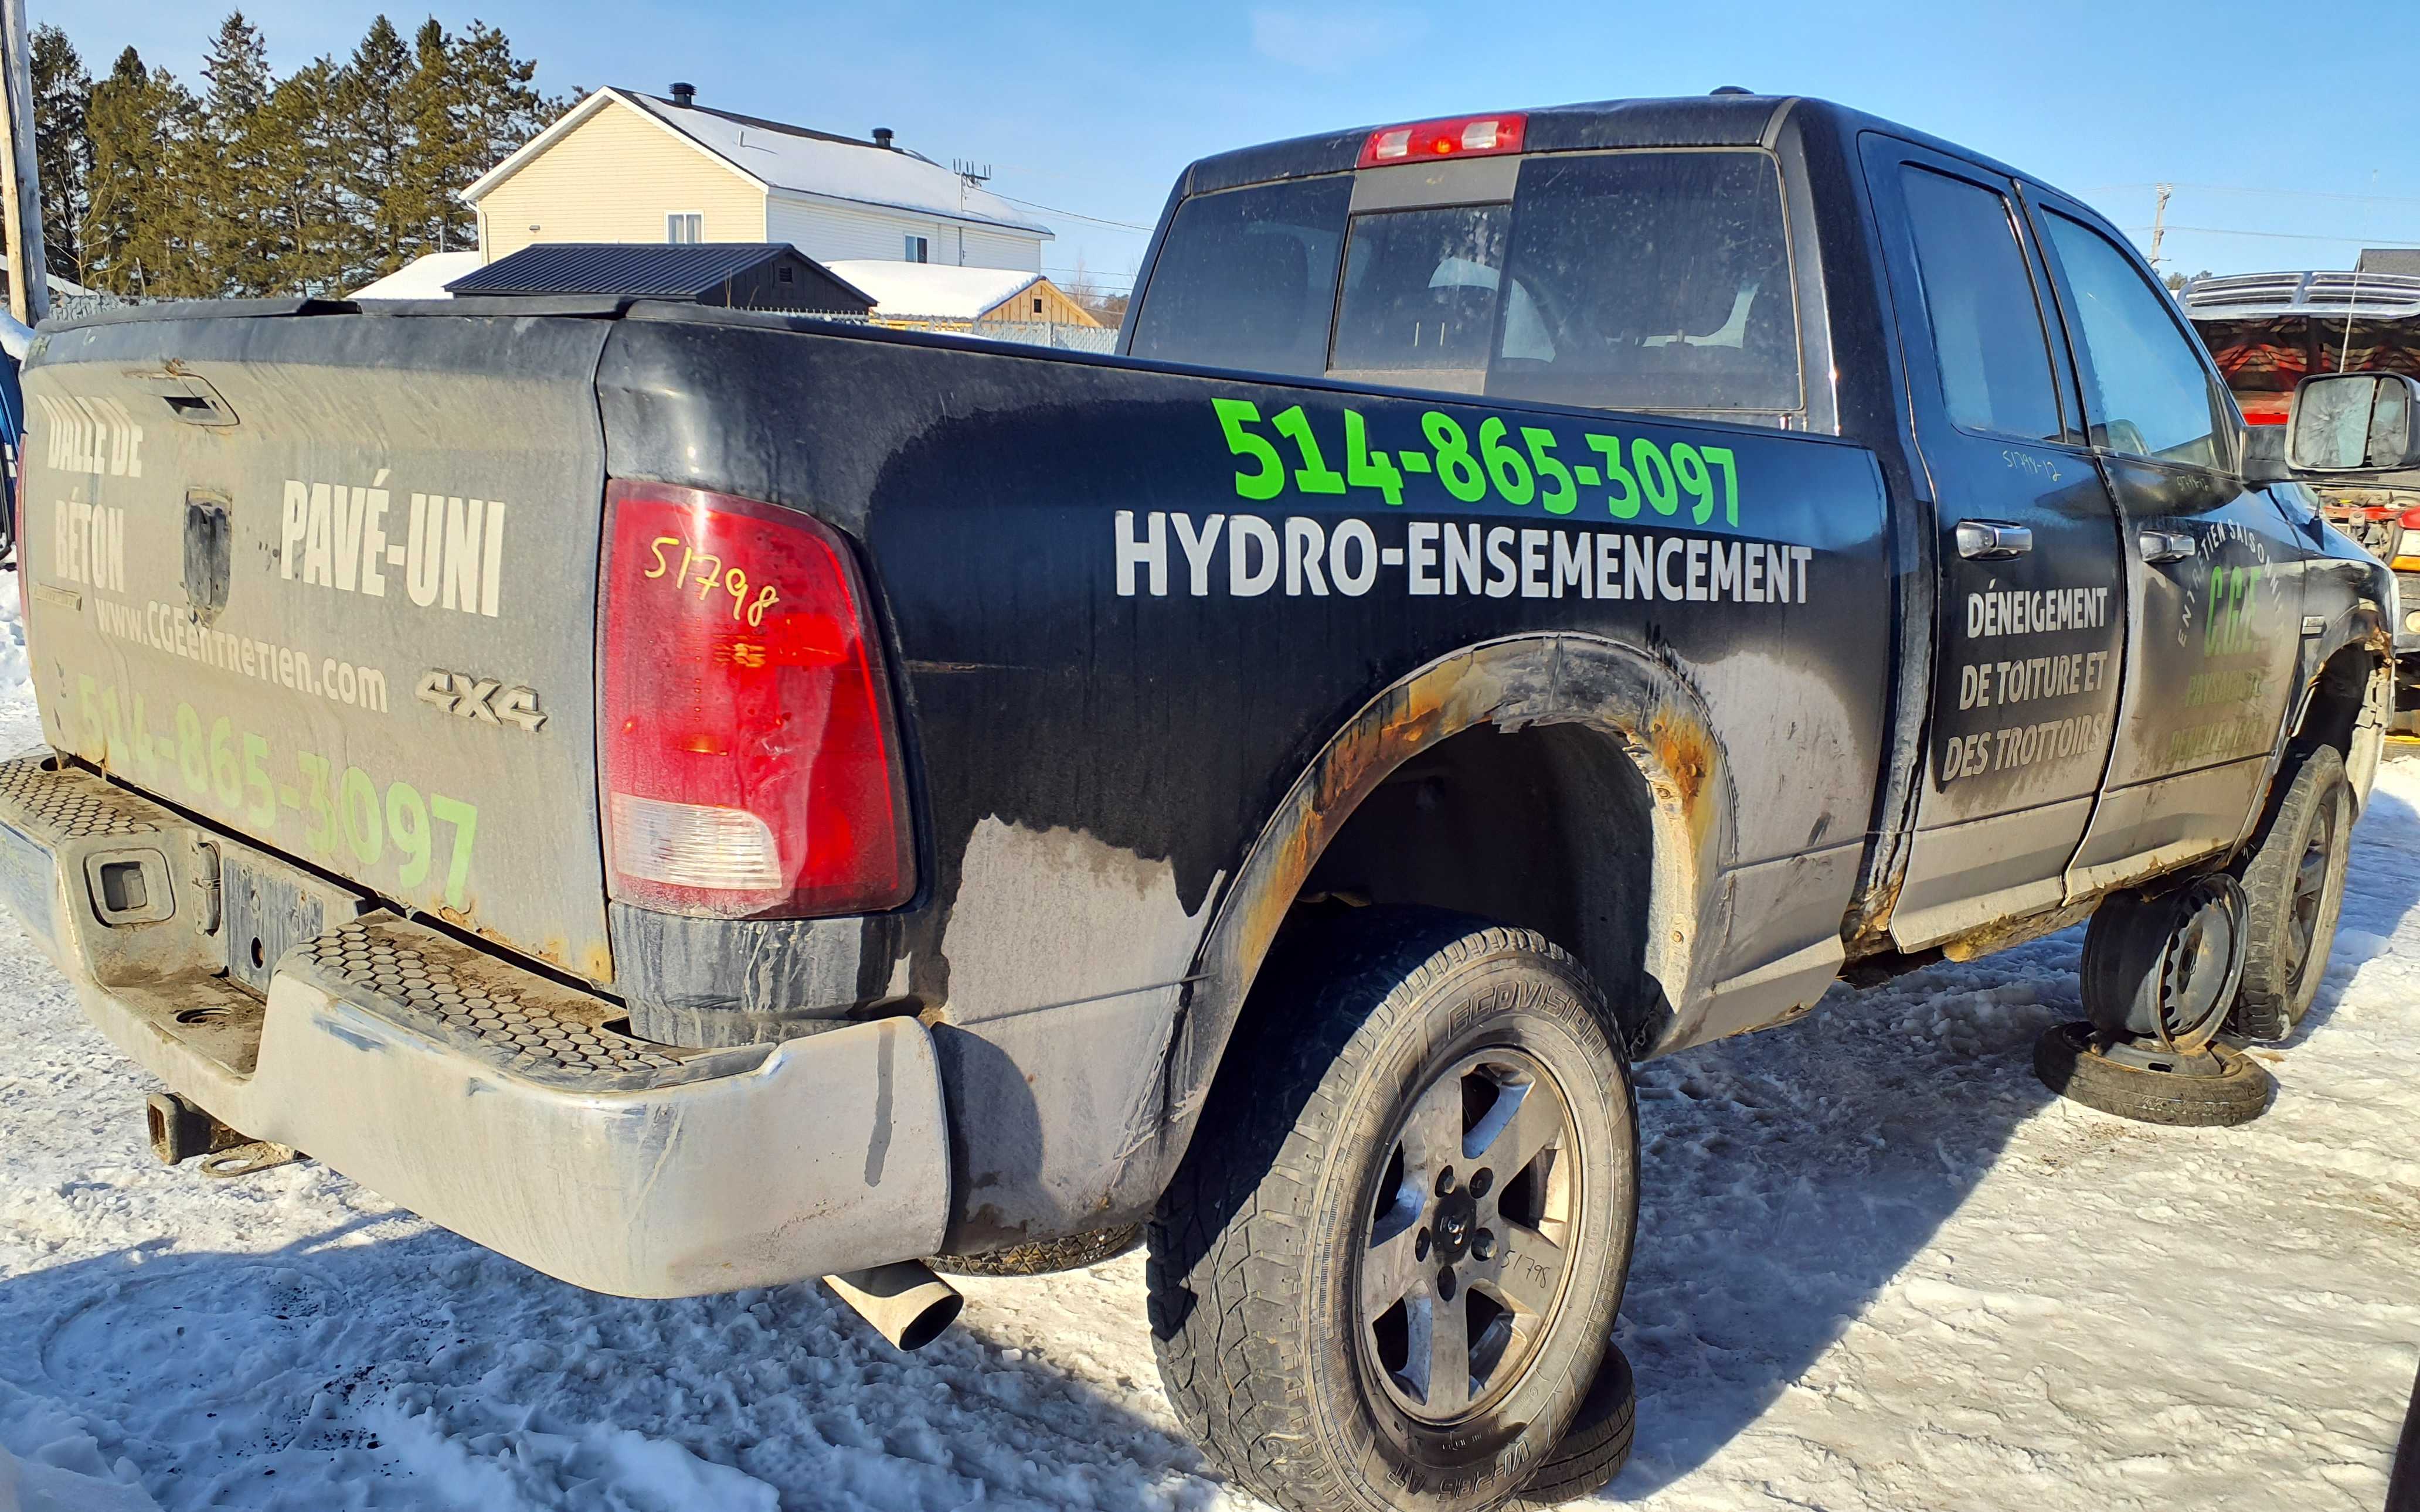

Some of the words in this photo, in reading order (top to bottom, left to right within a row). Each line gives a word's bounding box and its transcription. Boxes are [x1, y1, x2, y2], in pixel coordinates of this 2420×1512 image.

[37, 394, 107, 474] DALLE
[90, 396, 143, 478] DE
[1211, 397, 1741, 527] 514-865-3097
[56, 486, 124, 594] BÉTON
[281, 468, 506, 618] PAVÉ-UNI
[645, 537, 779, 626] 51798
[1115, 510, 1812, 605] HYDRO-ENSEMENCEMENT
[2227, 517, 2285, 638] SAISONNI
[1967, 578, 2108, 638] DÉNEIGEMENT
[1959, 664, 1992, 710] DE
[1997, 653, 2082, 705] TOITURE
[2084, 651, 2108, 692] ET
[78, 673, 478, 908] 514-865-3097
[1942, 731, 1992, 782] DES
[1994, 713, 2106, 771] TROTTOIRS
[1447, 980, 1608, 1059] ECOVISION
[1500, 1249, 1551, 1289] 51798
[1387, 1461, 1426, 1495] AT
